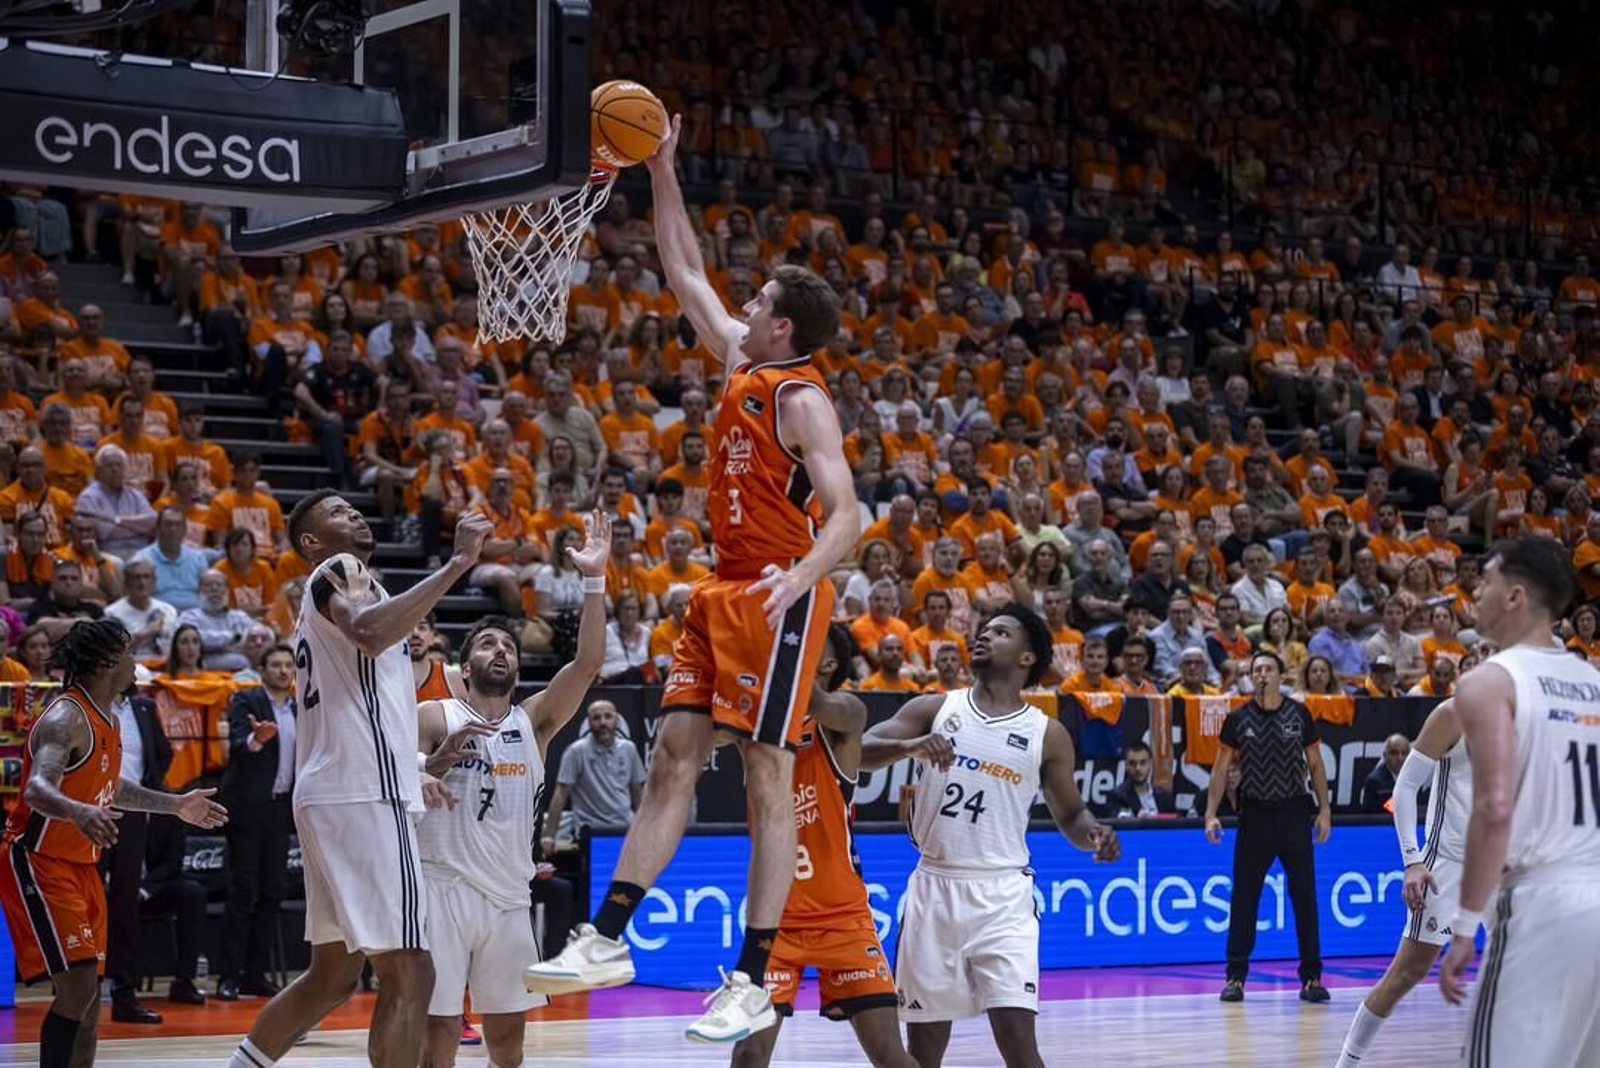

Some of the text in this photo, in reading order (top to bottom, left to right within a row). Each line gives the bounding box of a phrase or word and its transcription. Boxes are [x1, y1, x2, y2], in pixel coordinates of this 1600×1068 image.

[35, 115, 300, 183] endesa
[728, 489, 742, 524] 3
[477, 787, 495, 822] 7
[940, 782, 986, 824] 24
